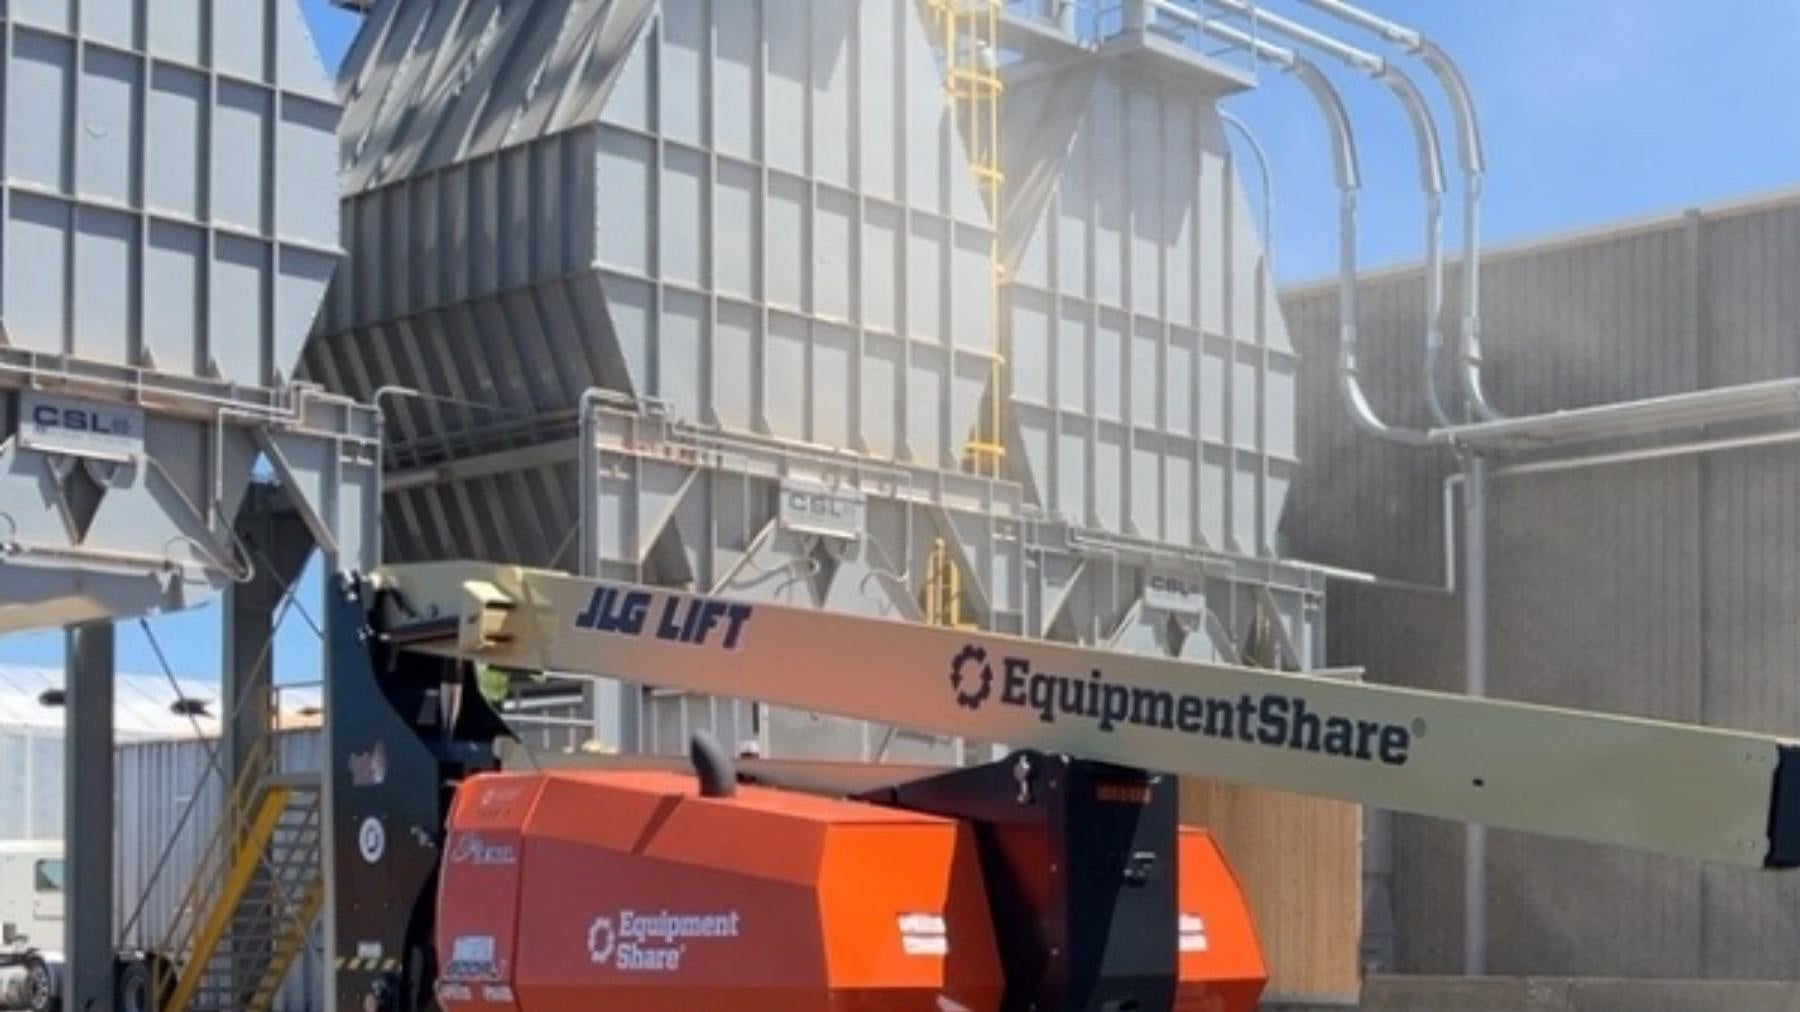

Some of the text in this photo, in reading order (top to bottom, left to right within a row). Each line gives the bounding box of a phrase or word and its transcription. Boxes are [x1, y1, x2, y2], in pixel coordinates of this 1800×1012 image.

[575, 586, 754, 650] JLG LIFT
[1001, 657, 1412, 766] EquipmentShare
[619, 909, 741, 943] Equipment
[616, 942, 680, 971] Share
